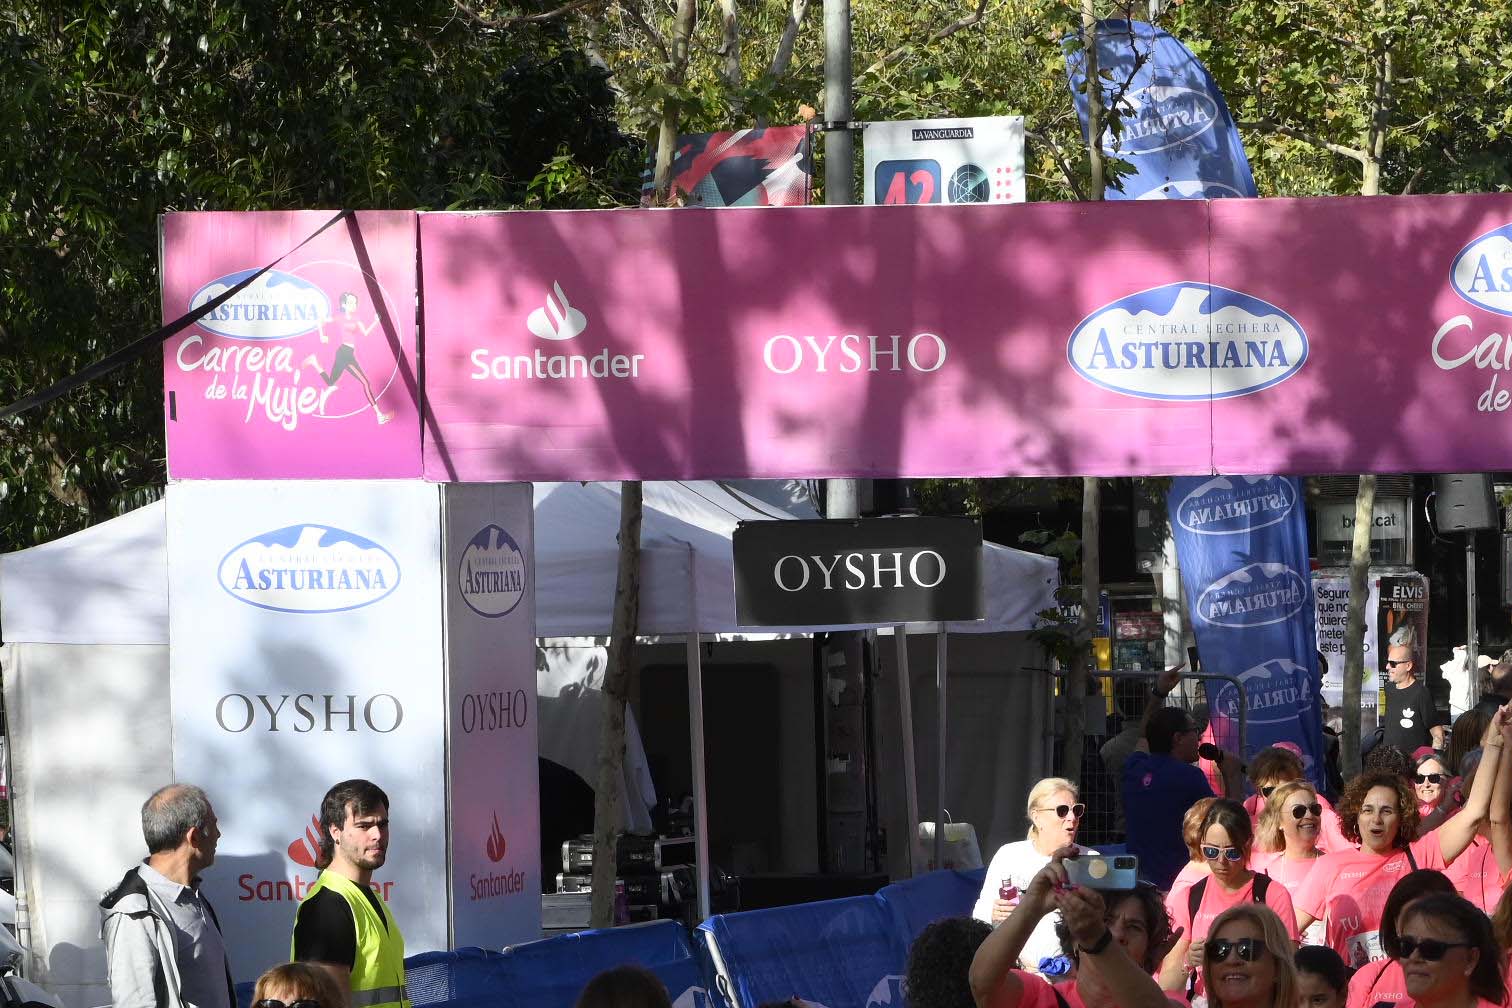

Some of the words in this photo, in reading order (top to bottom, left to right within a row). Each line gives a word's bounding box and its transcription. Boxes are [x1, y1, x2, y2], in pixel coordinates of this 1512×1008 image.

[201, 294, 319, 321] ASTURIANA
[1123, 322, 1200, 335] CENTRAL
[1205, 321, 1280, 335] LECHERA
[176, 335, 293, 372] Carrera
[470, 348, 645, 380] Santander
[762, 333, 947, 374] OYSHO
[1086, 327, 1290, 370] ASTURIANA
[204, 375, 228, 400] de
[231, 373, 248, 400] la
[245, 370, 338, 432] Mujer
[1477, 373, 1512, 412] de
[231, 557, 388, 592] ASTURIANA
[463, 562, 523, 596] ASTURIANA
[773, 550, 947, 592] OYSHO
[1318, 603, 1334, 616] que
[1392, 586, 1424, 600] ELVIS
[1318, 613, 1348, 627] quiere
[1319, 643, 1338, 654] este
[214, 692, 405, 734] OYSHO
[460, 688, 528, 735] OYSHO
[237, 873, 395, 902] Santer
[469, 867, 525, 901] Santander
[1340, 915, 1359, 932] TU
